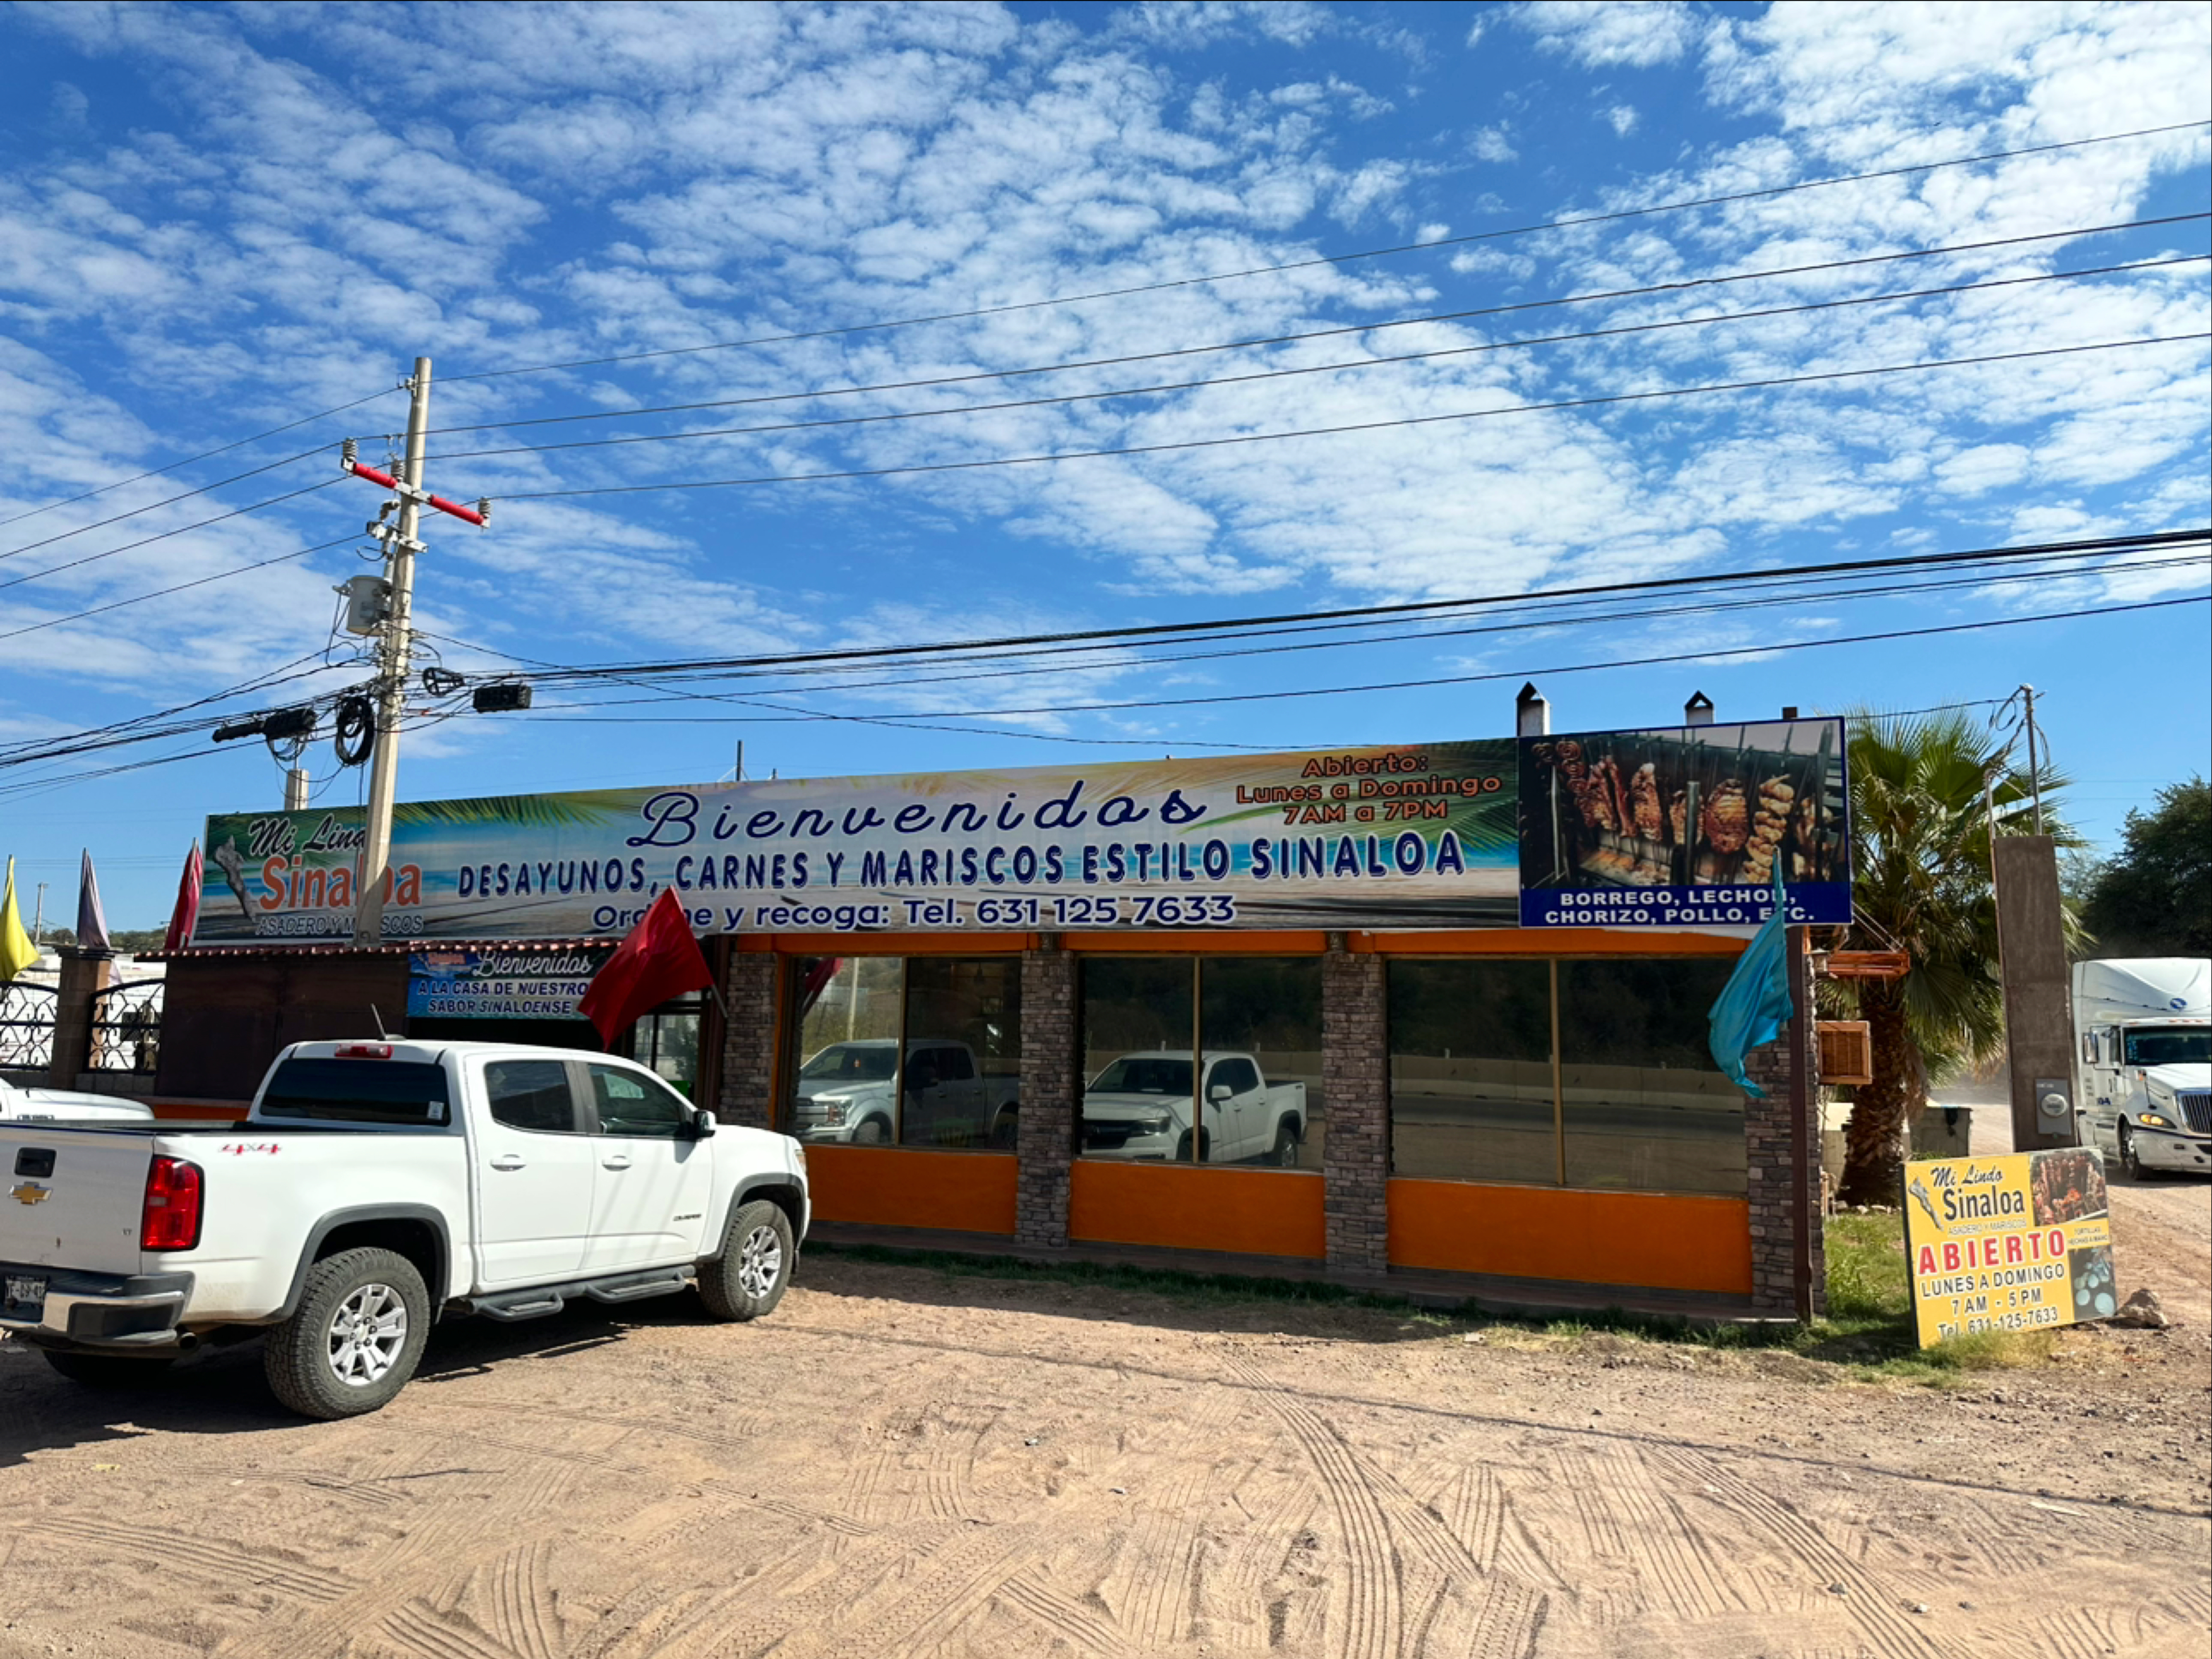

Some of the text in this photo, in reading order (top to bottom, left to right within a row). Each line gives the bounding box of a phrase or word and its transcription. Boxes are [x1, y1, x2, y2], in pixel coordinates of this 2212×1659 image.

[1302, 754, 1427, 778] Abierto:
[1236, 774, 1502, 803] Lunes a Domingo
[626, 780, 1207, 847] Bienvenidos
[1283, 800, 1447, 825] 7AM a 7PM
[249, 817, 297, 855] Mi
[459, 832, 1465, 897] DESAYUNOS, CARNES Y MARISCOS ESTILO SINALOA
[1560, 891, 1680, 906] BORREGO,
[723, 907, 743, 929] y
[755, 904, 889, 931] recoga:
[903, 899, 963, 924] Tel.
[977, 899, 1038, 923] 631
[1054, 898, 1117, 923] 125
[1131, 896, 1234, 922] 7633
[1545, 909, 1657, 925] CHORIZO,
[1665, 908, 1751, 923] POLLO,
[471, 949, 593, 977] Bienvenidos
[418, 981, 590, 995] A LA CASA DE NUESTRO
[429, 1000, 572, 1015] SABOR SINALOENSE
[1930, 1164, 2003, 1187] Mi Lindo
[1943, 1185, 2025, 1221] Sinaloa
[1918, 1231, 2065, 1275] ABIERTO
[1921, 1263, 2065, 1297] LUNES A DOMINGO
[1951, 1300, 1958, 1314] 7
[1965, 1296, 1987, 1313] AM
[2009, 1292, 2017, 1307] 5
[2021, 1288, 2042, 1305] PM
[1967, 1307, 2058, 1335] 631-125-7633
